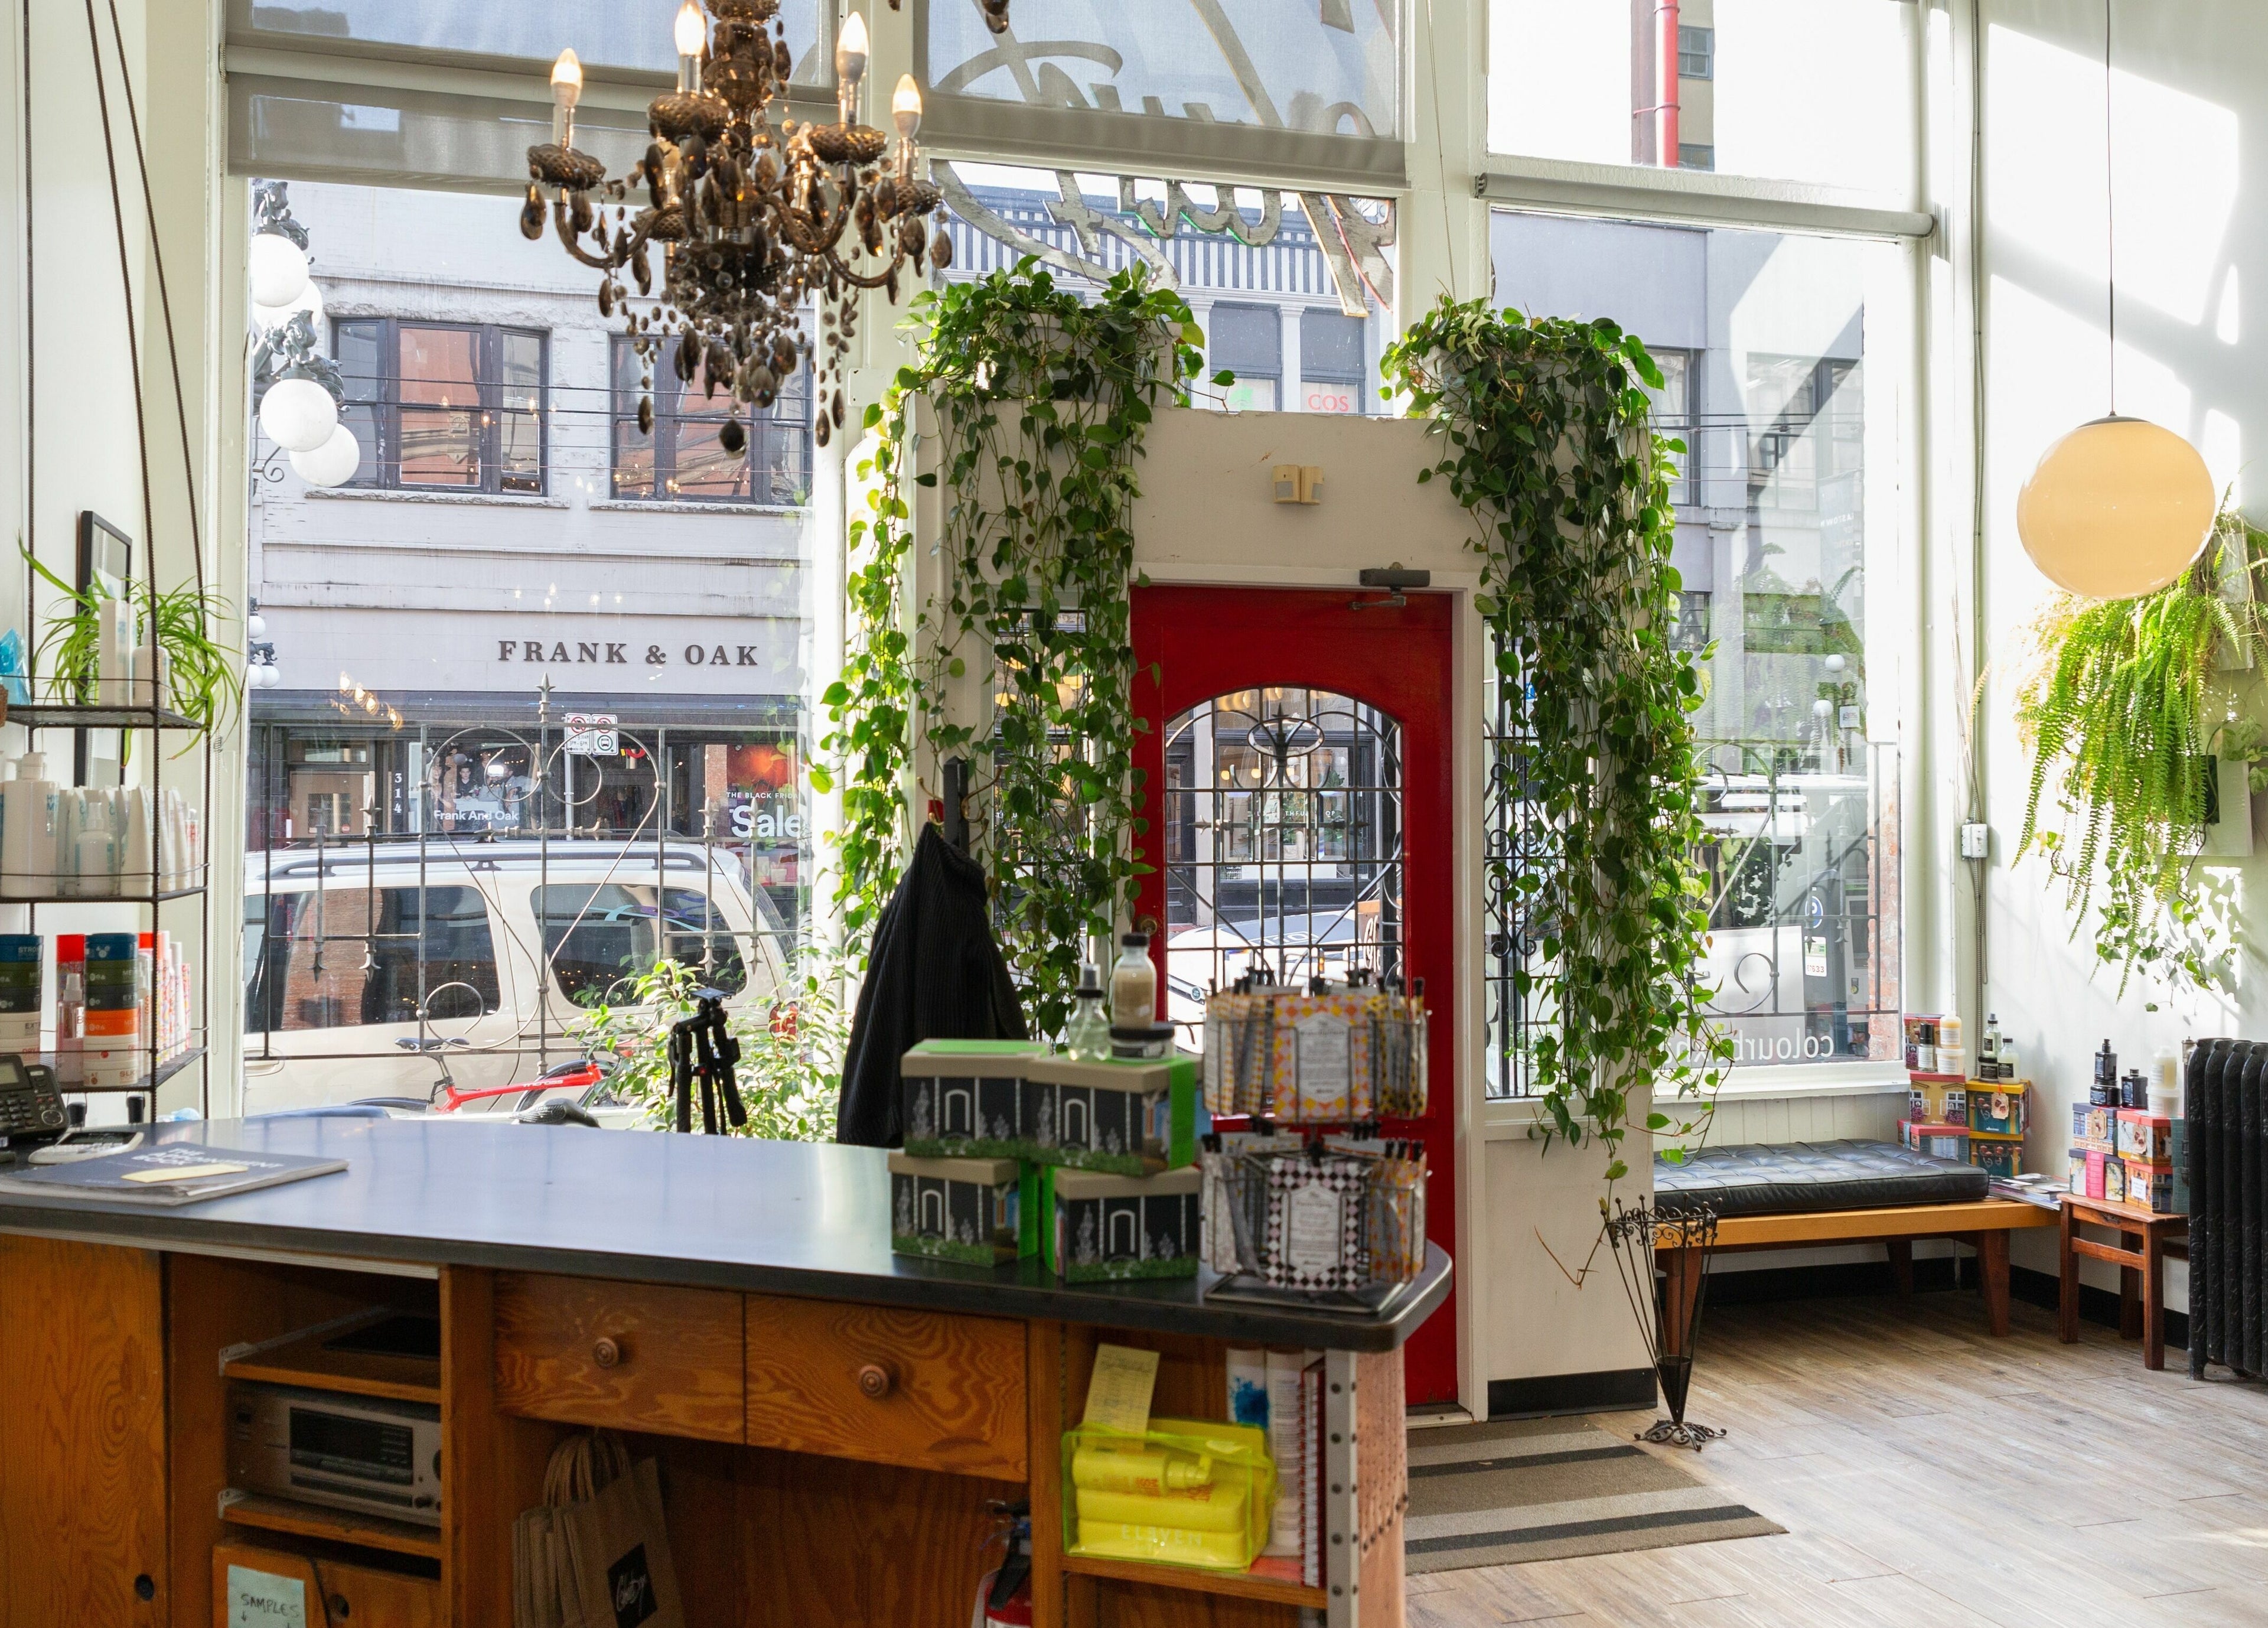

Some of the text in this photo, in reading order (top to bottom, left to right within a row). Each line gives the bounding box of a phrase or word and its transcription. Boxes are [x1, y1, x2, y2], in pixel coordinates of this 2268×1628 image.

[1308, 393, 1350, 412] COS
[497, 640, 758, 666] FRANK & OAK
[434, 809, 519, 821] Frank And Oak
[731, 805, 800, 838] Sale
[240, 1592, 300, 1619] SAMPLES
